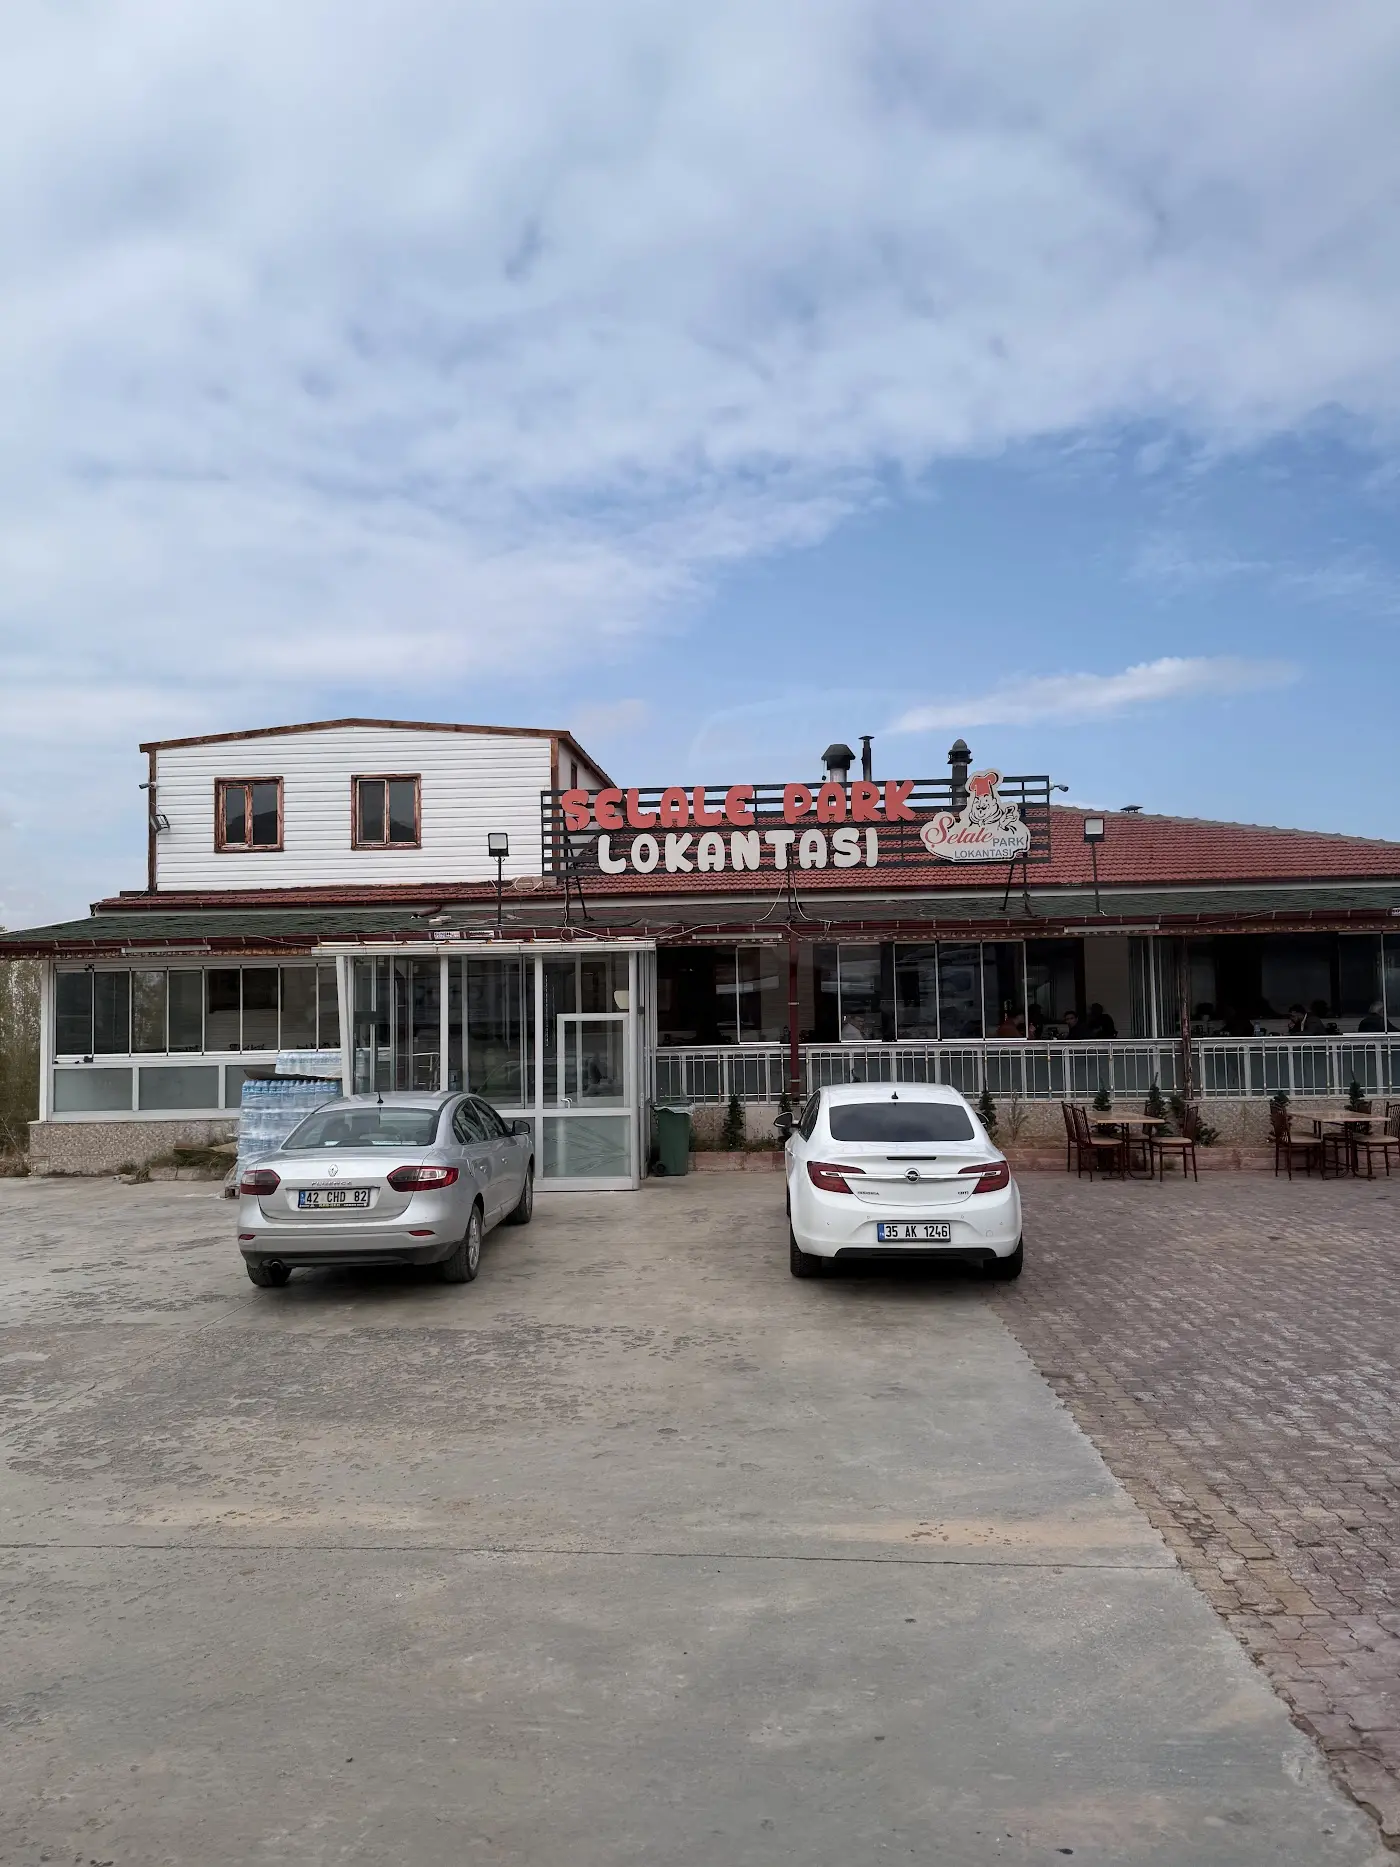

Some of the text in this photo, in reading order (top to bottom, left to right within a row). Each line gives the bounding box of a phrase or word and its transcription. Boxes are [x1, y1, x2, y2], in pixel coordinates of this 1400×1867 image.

[783, 780, 917, 825] PARK
[992, 836, 1025, 847] PARK
[598, 827, 879, 874] LOKANTASI
[954, 848, 1012, 859] LOKANTASI
[306, 1190, 367, 1204] 42 CHD 82
[885, 1225, 948, 1238] 35 AK 1246
